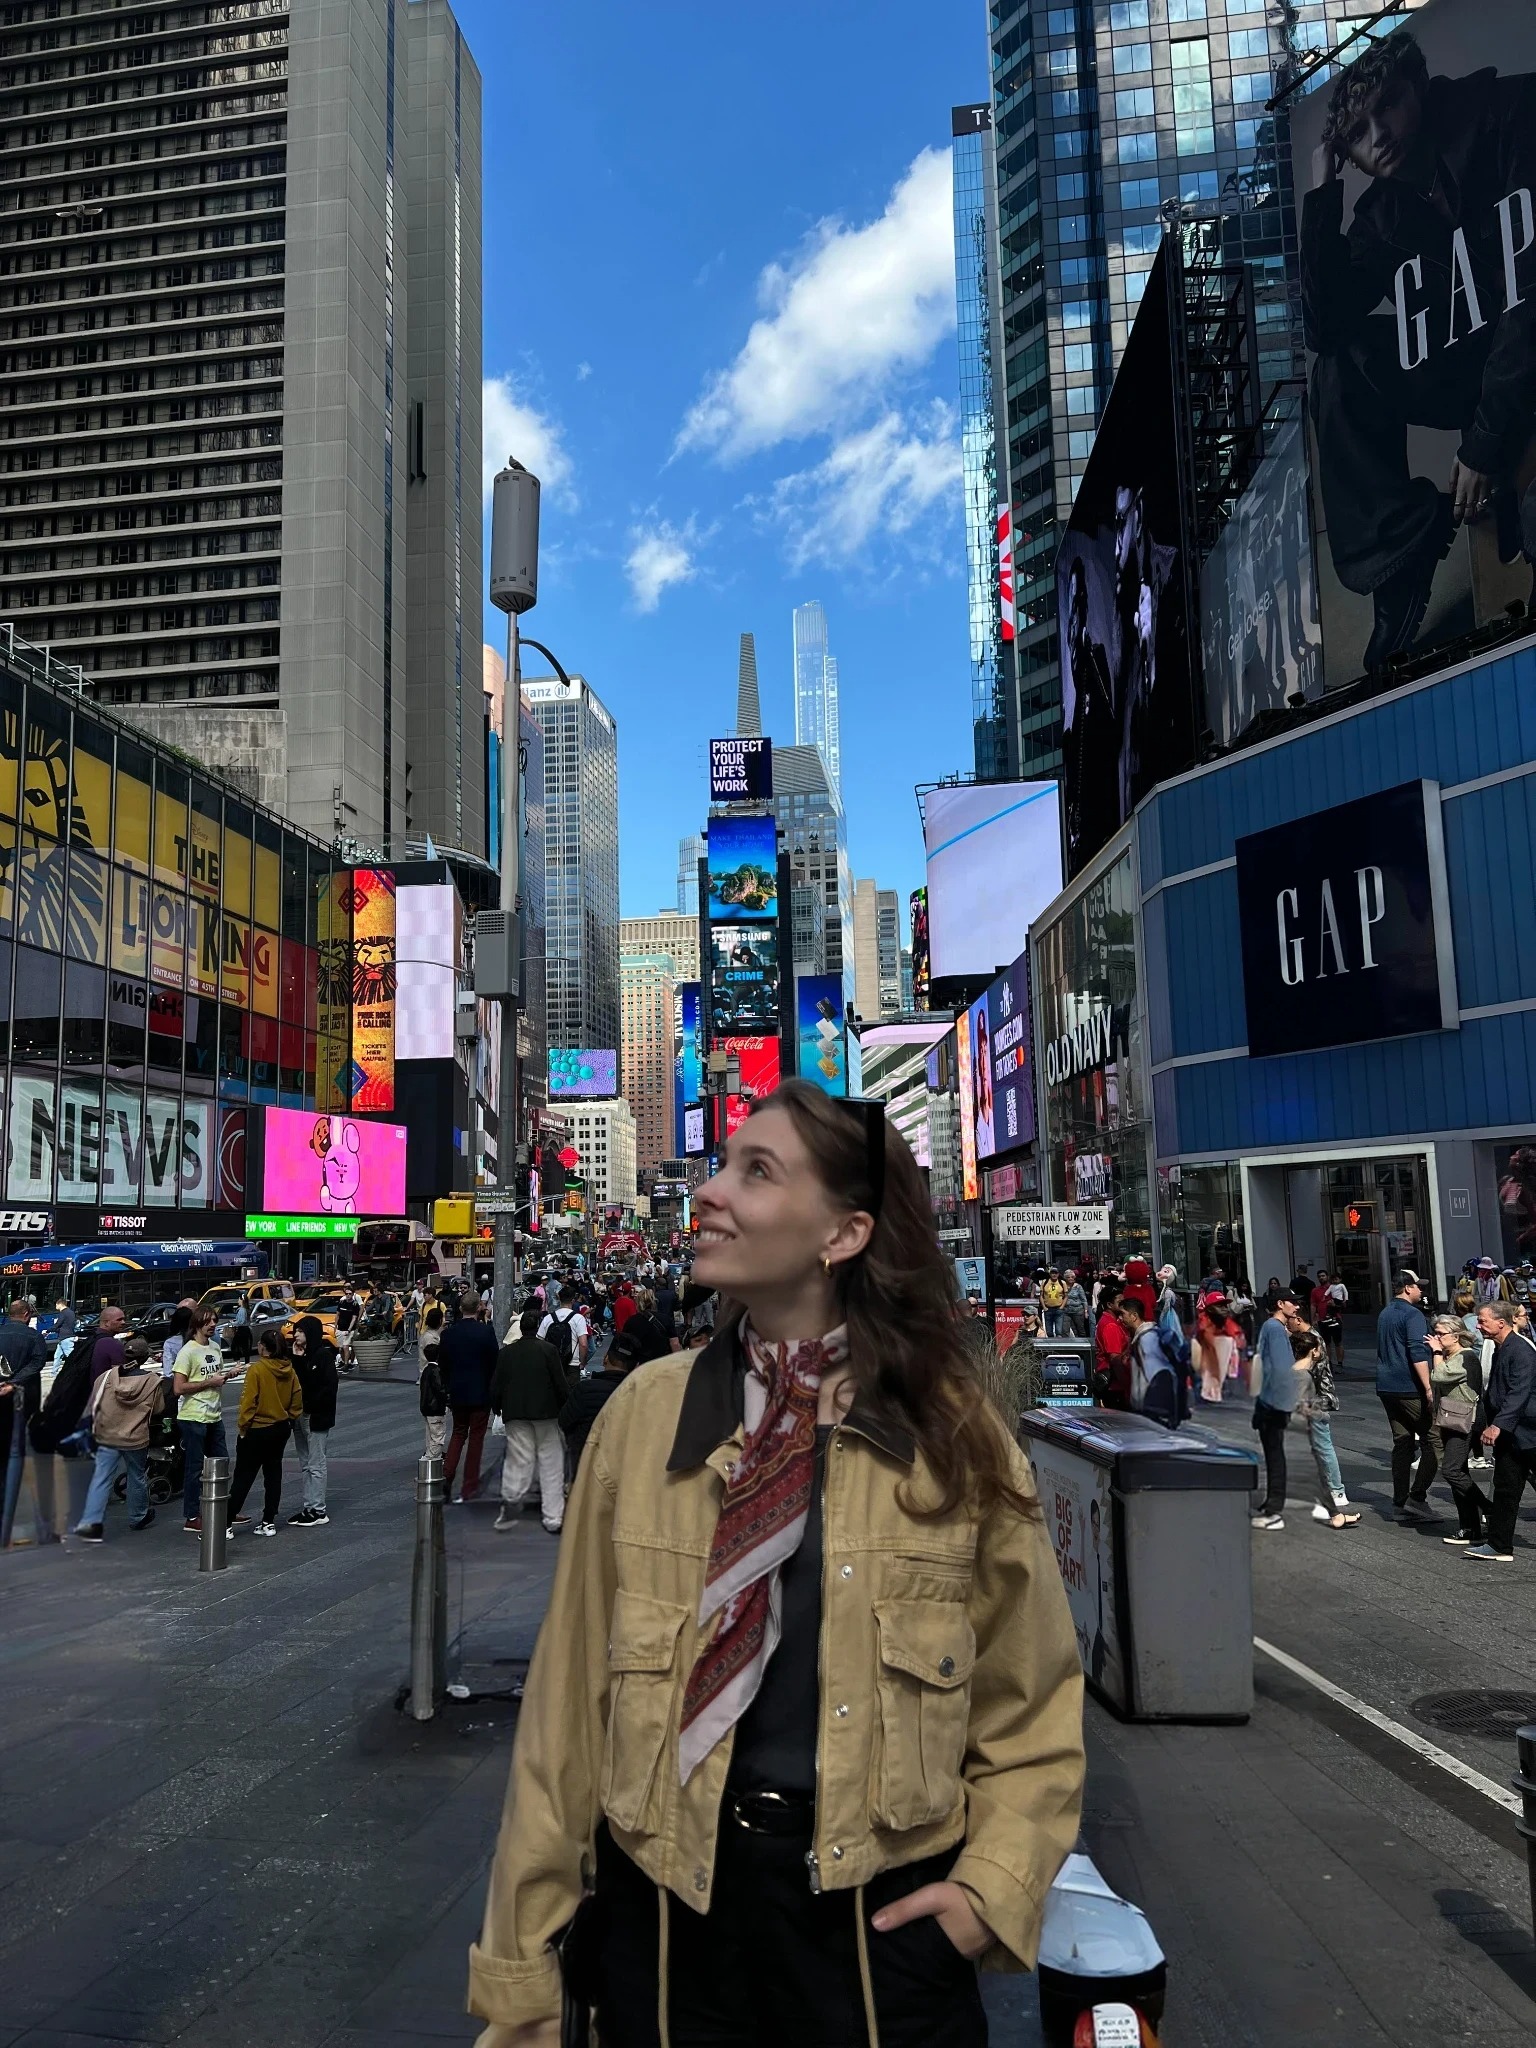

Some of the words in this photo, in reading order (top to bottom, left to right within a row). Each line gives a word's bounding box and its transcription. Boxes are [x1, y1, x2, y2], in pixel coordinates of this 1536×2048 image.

[1394, 187, 1535, 370] GAP
[1243, 590, 1273, 636] loose.
[1300, 650, 1316, 692] GAP
[712, 740, 763, 753] PROTECT
[712, 754, 744, 765] YOUR
[713, 766, 745, 778] LIFE'S
[713, 779, 748, 792] WORK
[174, 834, 219, 887] THE
[1276, 864, 1387, 986] GAP
[202, 895, 270, 977] KING
[720, 932, 768, 942] SAMSUNG
[725, 971, 764, 981] CRIME
[153, 968, 182, 983] ENTRANCE
[190, 978, 199, 988] ON
[201, 983, 215, 993] 45TH
[221, 988, 238, 1000] STREET
[363, 1020, 391, 1028] CALLING
[1047, 1034, 1070, 1087] OLD
[1073, 1004, 1112, 1074] NAVY
[30, 1097, 202, 1191] NEWS
[1453, 1197, 1466, 1209] GAP
[0, 1211, 48, 1232] ERS
[113, 1216, 147, 1227] TISSOT
[1006, 1212, 1055, 1222] PEDESTRIAN
[1058, 1211, 1079, 1221] FLOW
[1083, 1211, 1103, 1221] ZONE
[258, 1221, 277, 1232] YORK
[286, 1222, 300, 1232] LINE
[301, 1222, 326, 1233] FRIENDS
[334, 1223, 347, 1232] NEW
[1007, 1225, 1027, 1236] KEEP
[1030, 1225, 1060, 1235] MOVING
[161, 1243, 201, 1253] clean-energy
[201, 1243, 214, 1252] bus
[454, 1242, 465, 1257] BIG
[475, 1244, 490, 1256] NEW
[1055, 1492, 1073, 1527] BIG
[1057, 1522, 1072, 1552] OF
[1054, 1549, 1082, 1592] EART
